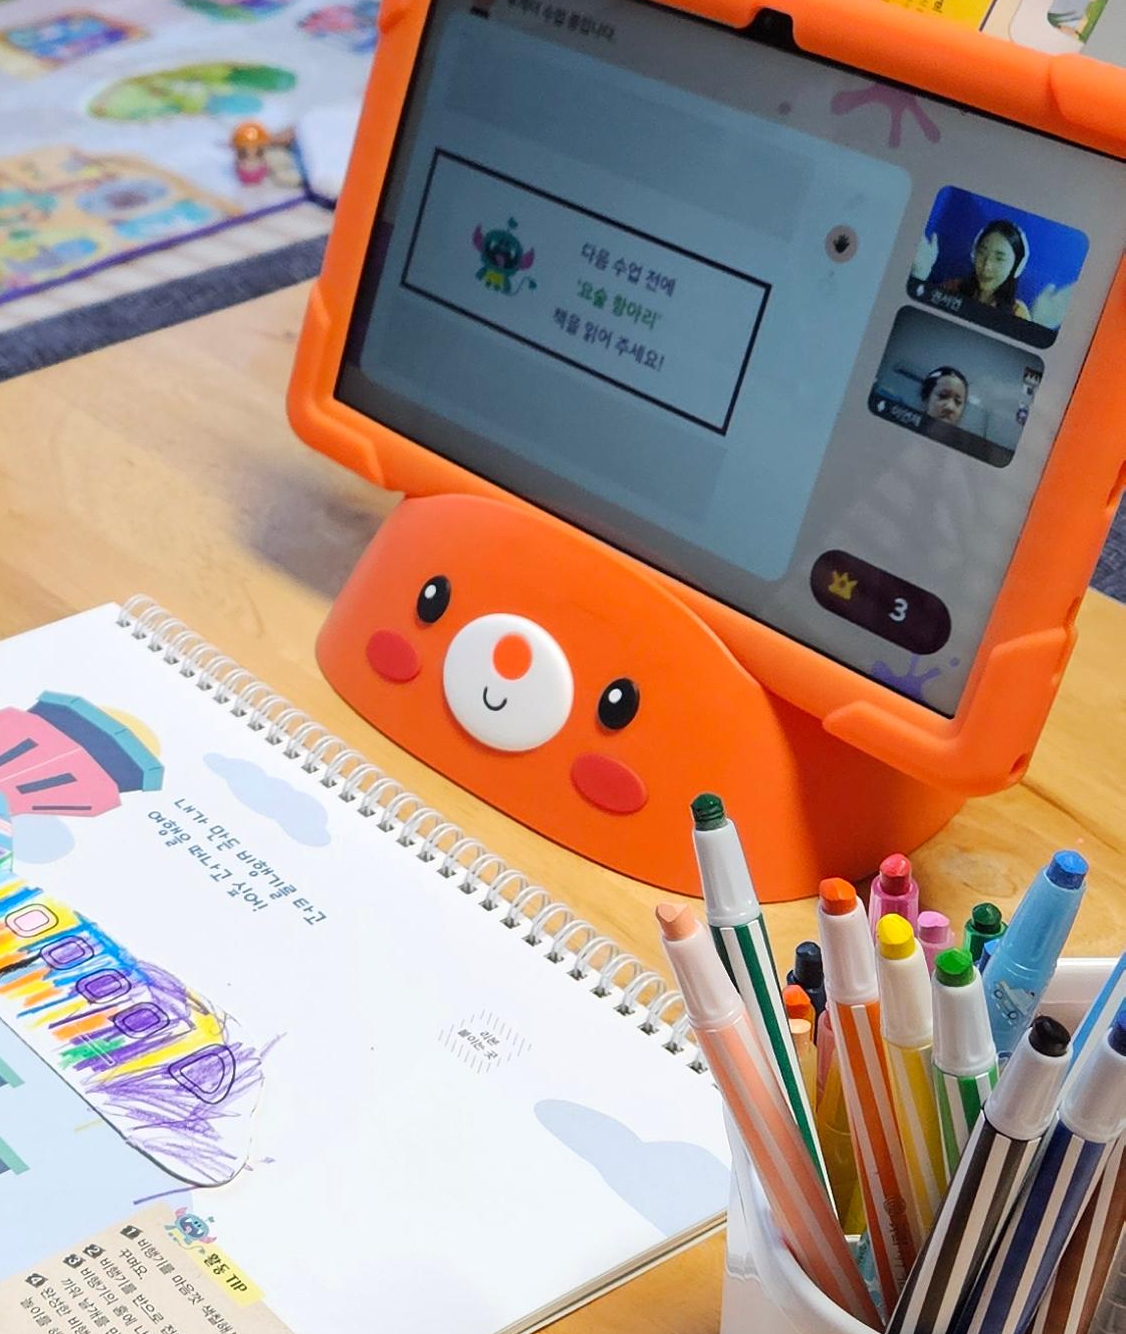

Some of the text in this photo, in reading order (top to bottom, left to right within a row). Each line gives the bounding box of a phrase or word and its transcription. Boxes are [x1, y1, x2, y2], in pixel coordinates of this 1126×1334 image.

[581, 242, 676, 297] 다음 수업 전에
[553, 307, 665, 372] 책을 읽어 주세요!
[889, 598, 908, 622] 3
[147, 810, 268, 912] 여행을 떠나고 싶어!
[174, 798, 327, 926] 내가 만든 비행기를 타고
[80, 1267, 119, 1305] 비행기의
[119, 1249, 148, 1280] 꾸며요.
[138, 1238, 175, 1275] 비행기를
[172, 1274, 205, 1306] 마음껏
[203, 1253, 248, 1293] 활동 TIP
[20, 1297, 52, 1327] 놀이를
[40, 1286, 73, 1317] 완성한
[61, 1278, 84, 1299] 끼워
[78, 1297, 110, 1327] 날개를
[100, 1257, 137, 1294] 비행기를
[132, 1294, 164, 1324] 반으로
